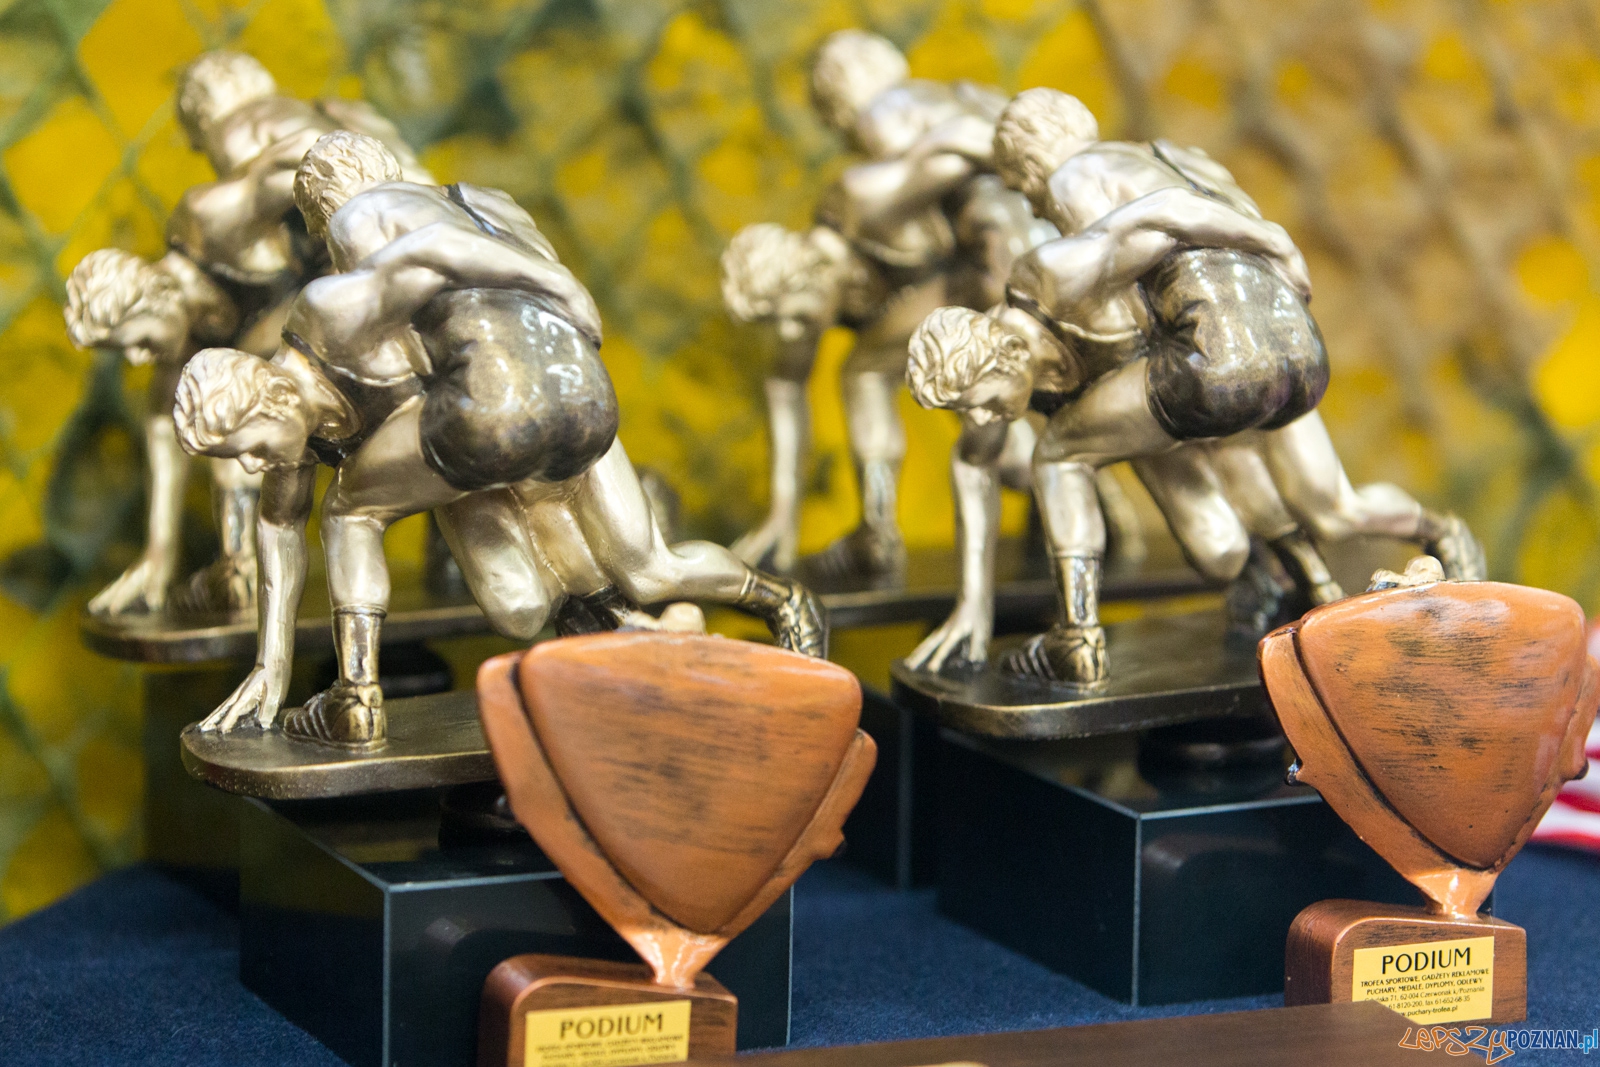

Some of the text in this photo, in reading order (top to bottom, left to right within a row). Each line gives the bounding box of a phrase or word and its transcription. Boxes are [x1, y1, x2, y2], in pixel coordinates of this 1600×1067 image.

[1381, 947, 1471, 975] PODIUM
[1361, 979, 1384, 988] TROFEA
[1421, 972, 1450, 981] GADŻETY
[1451, 968, 1490, 978] REKLAMOWE
[1366, 987, 1397, 995] PUCHARY,
[1456, 977, 1483, 986] ODLEWY
[1400, 992, 1419, 1001] 62-004
[1420, 989, 1451, 998] Czerwonak
[560, 1013, 663, 1040] PODIUM
